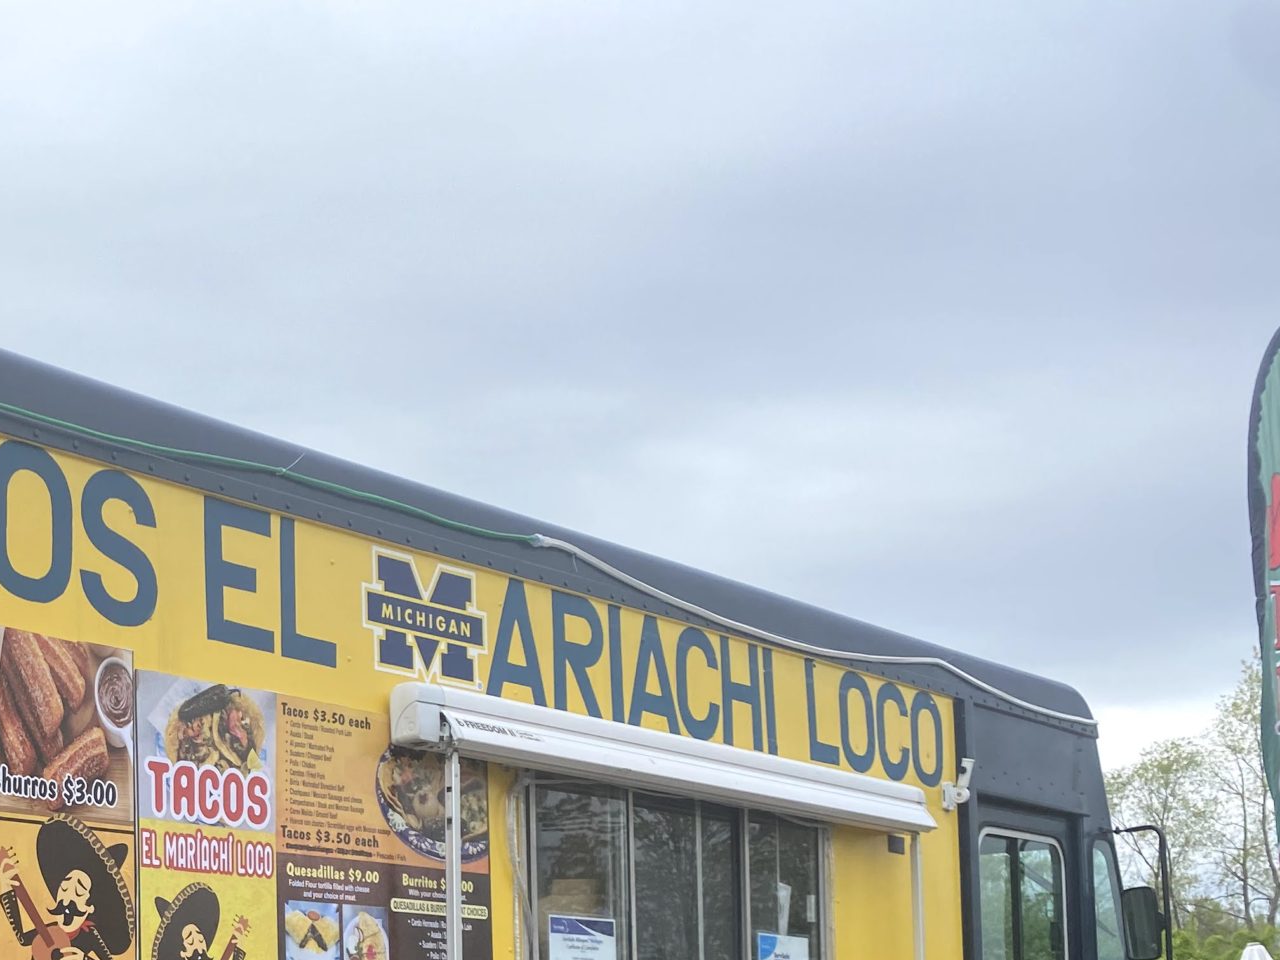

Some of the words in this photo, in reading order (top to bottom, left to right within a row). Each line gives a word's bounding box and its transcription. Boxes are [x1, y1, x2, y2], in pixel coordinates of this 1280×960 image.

[382, 603, 470, 638] MICHIGAN
[204, 496, 338, 669] EL
[805, 658, 944, 788] LOCO
[281, 702, 308, 719] Tacos
[313, 708, 345, 725] $3.50
[349, 717, 371, 729] each
[463, 720, 508, 735] FREEDOM
[63, 773, 117, 808] $3.00
[145, 757, 269, 829] TACOS
[281, 825, 311, 840] Tacos
[316, 830, 350, 845] $3.50
[355, 835, 379, 848] each
[142, 829, 160, 867] EL
[237, 842, 273, 877] LOCO
[286, 862, 345, 880] Quesadillas
[349, 868, 379, 883] $9.00
[402, 874, 437, 888] Burritos
[393, 900, 425, 912] QUESADILLAS
